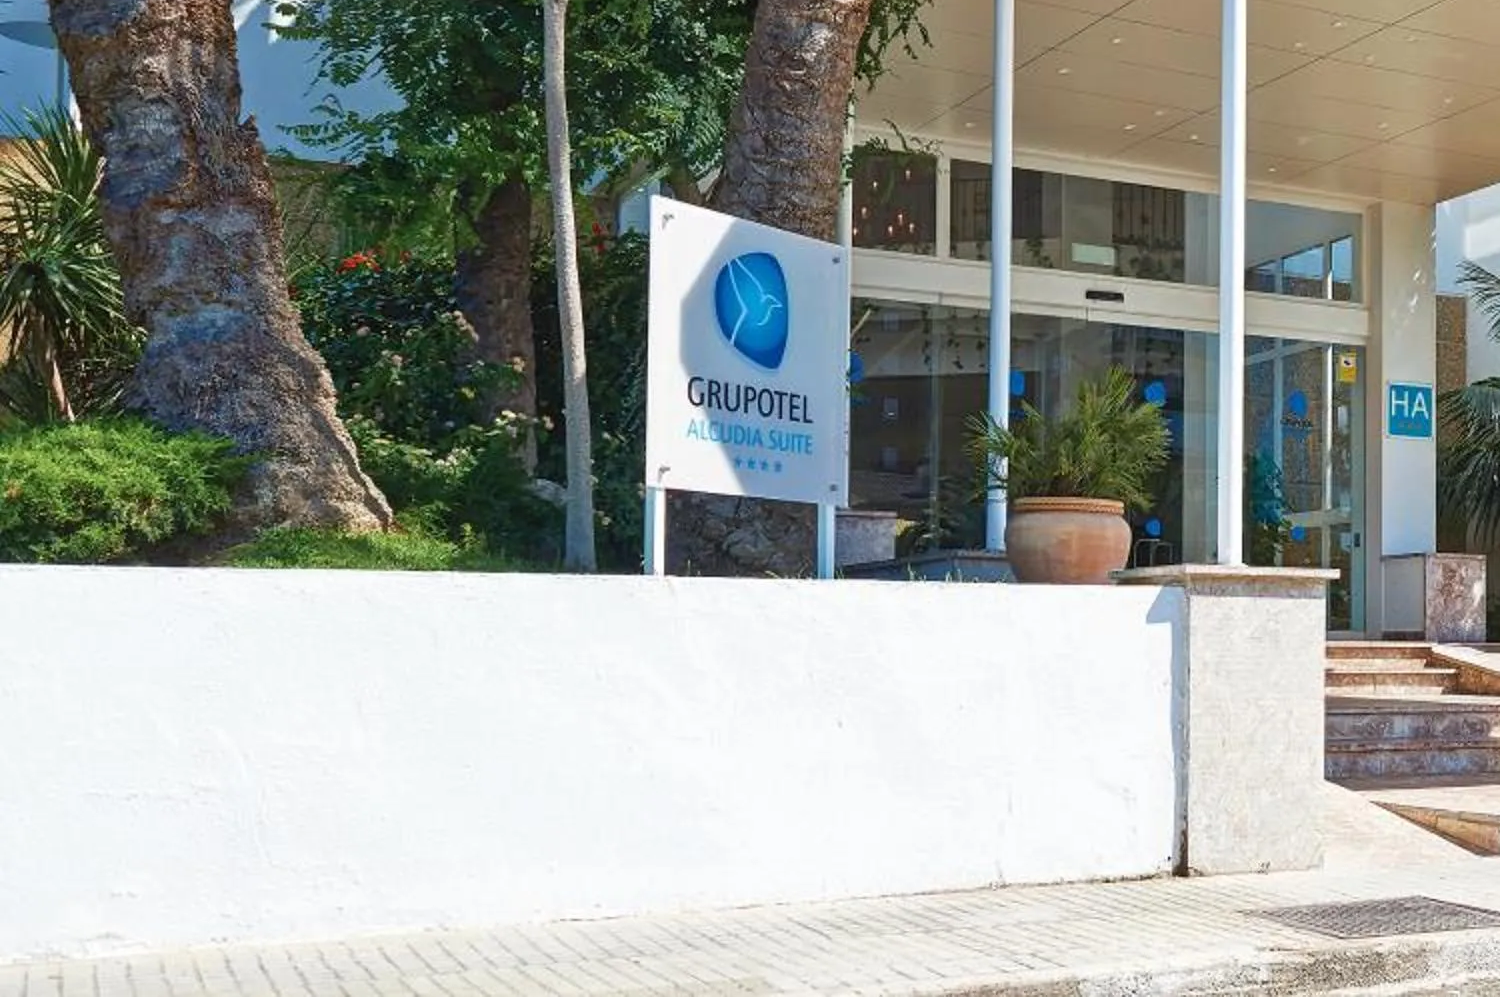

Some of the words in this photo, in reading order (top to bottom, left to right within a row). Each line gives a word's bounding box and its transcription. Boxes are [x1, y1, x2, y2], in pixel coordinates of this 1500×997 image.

[687, 376, 814, 424] GRUPOTEL
[686, 418, 764, 448] ALCUDIA
[768, 429, 814, 455] SUITE
